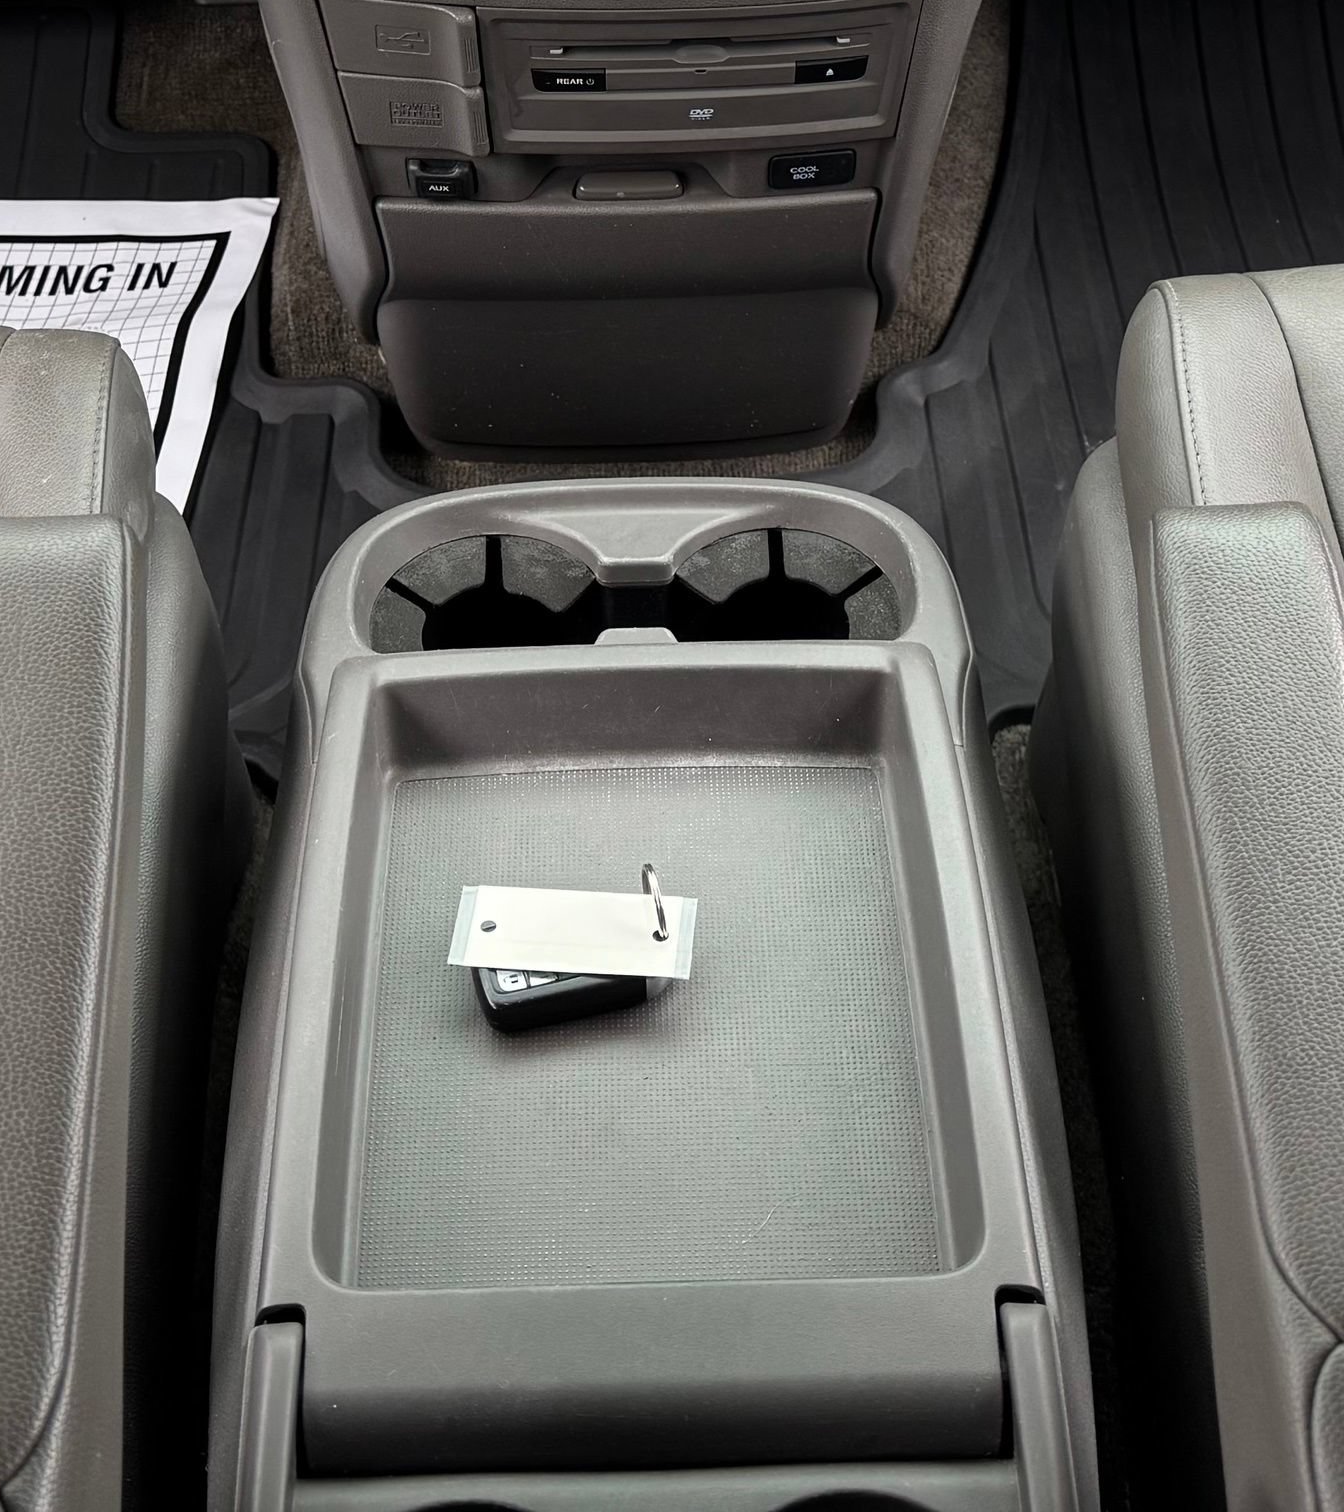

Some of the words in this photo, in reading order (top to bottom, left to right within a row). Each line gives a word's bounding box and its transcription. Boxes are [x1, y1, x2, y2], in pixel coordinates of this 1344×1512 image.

[790, 166, 820, 174] COOL
[792, 172, 816, 180] BOX
[428, 184, 450, 192] AUX
[127, 261, 179, 291] IN
